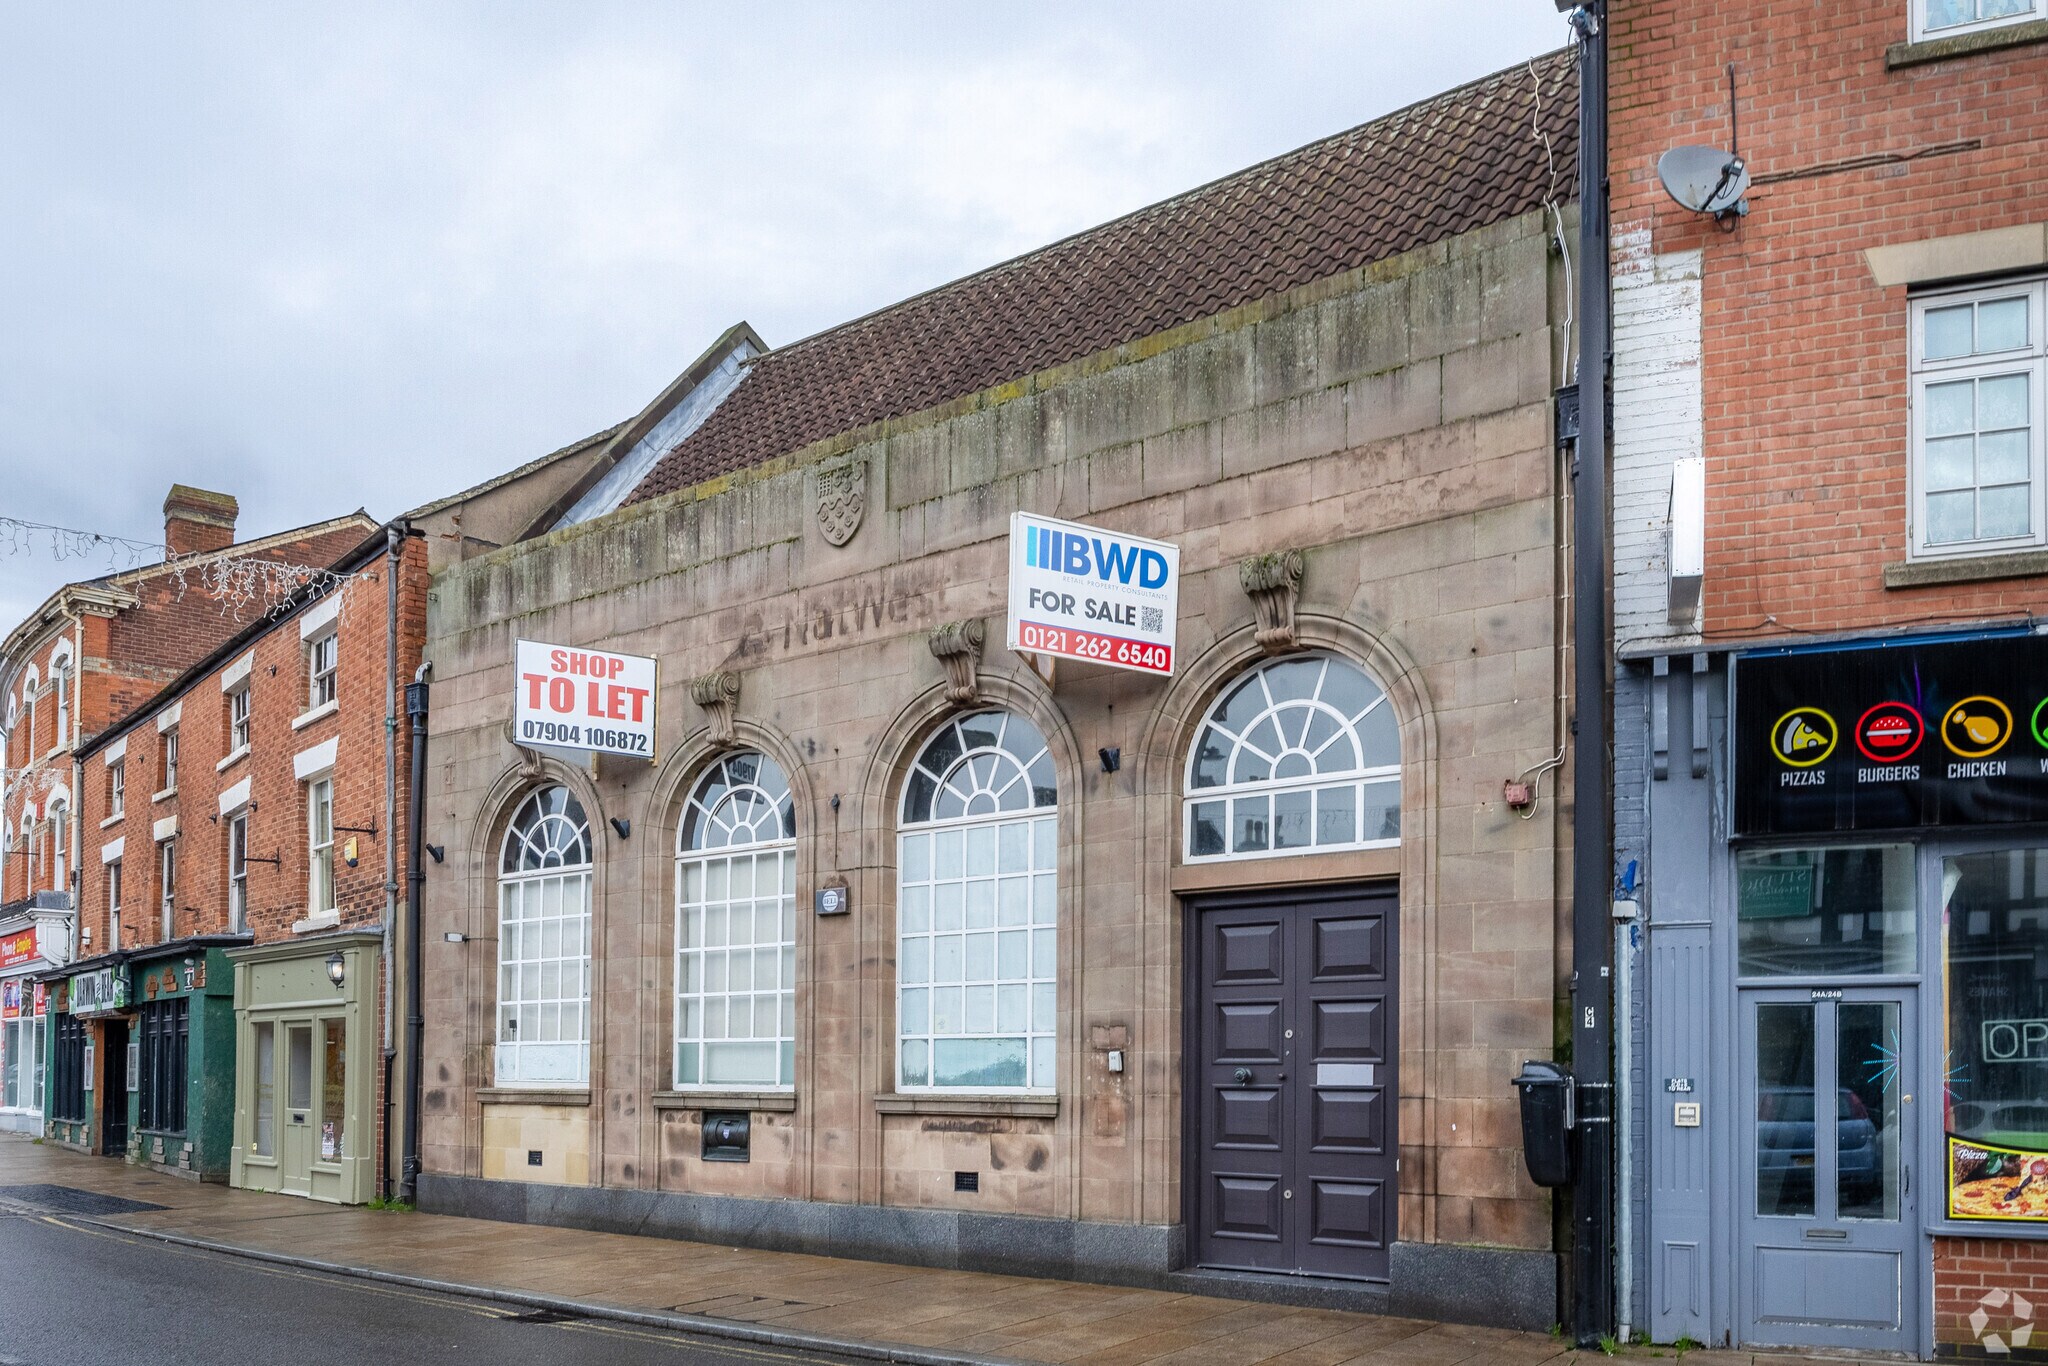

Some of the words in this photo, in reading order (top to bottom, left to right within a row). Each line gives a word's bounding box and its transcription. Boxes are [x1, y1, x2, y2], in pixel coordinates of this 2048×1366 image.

[1062, 575, 1084, 586] RETAIL
[1087, 579, 1120, 592] PROPERTY
[1121, 586, 1169, 601] CONSULTANTS
[1029, 587, 1076, 616] FOR
[1084, 597, 1136, 626] SALE
[1024, 626, 1067, 651] 0121
[1075, 635, 1112, 659] 262
[1117, 642, 1166, 668] 6540
[550, 649, 625, 680] SHOP
[522, 673, 575, 714] TO
[587, 681, 650, 723] LET
[523, 720, 581, 744] 07904
[584, 727, 647, 752] 106872
[1780, 770, 1826, 787] PIZZAS
[1857, 765, 1920, 783] BURGERS
[1947, 760, 2007, 779] CHICKEN
[1811, 990, 1842, 999] 24A/24B
[1957, 1148, 1989, 1160] Pizza
